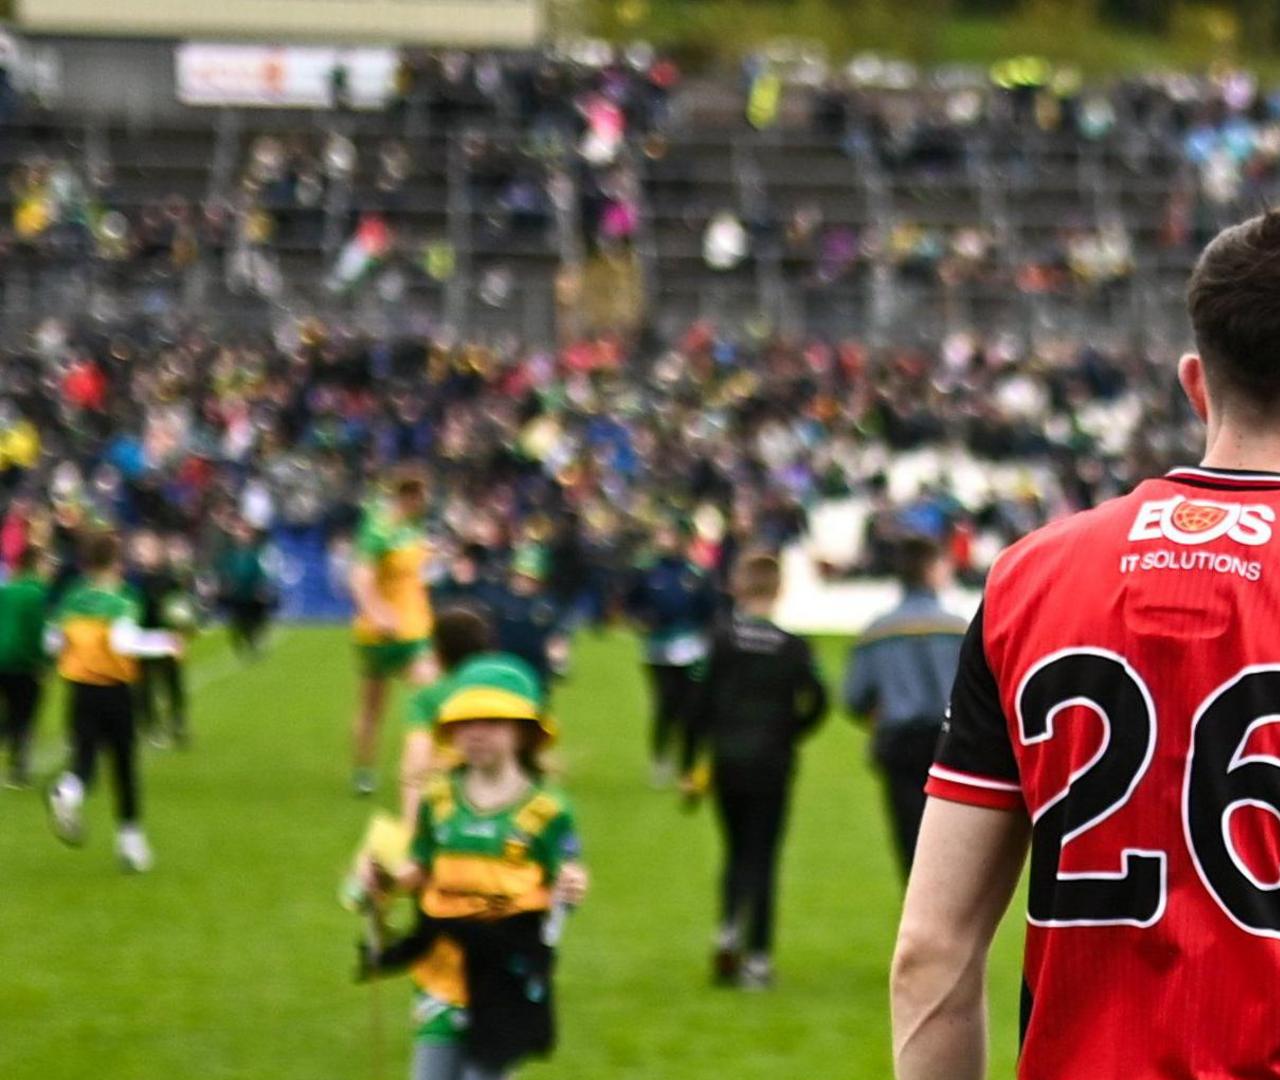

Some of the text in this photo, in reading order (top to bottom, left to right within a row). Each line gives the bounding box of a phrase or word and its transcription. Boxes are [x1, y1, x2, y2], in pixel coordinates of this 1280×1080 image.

[1128, 494, 1276, 546] EOS
[1120, 551, 1261, 581] IT SOLUTIONS
